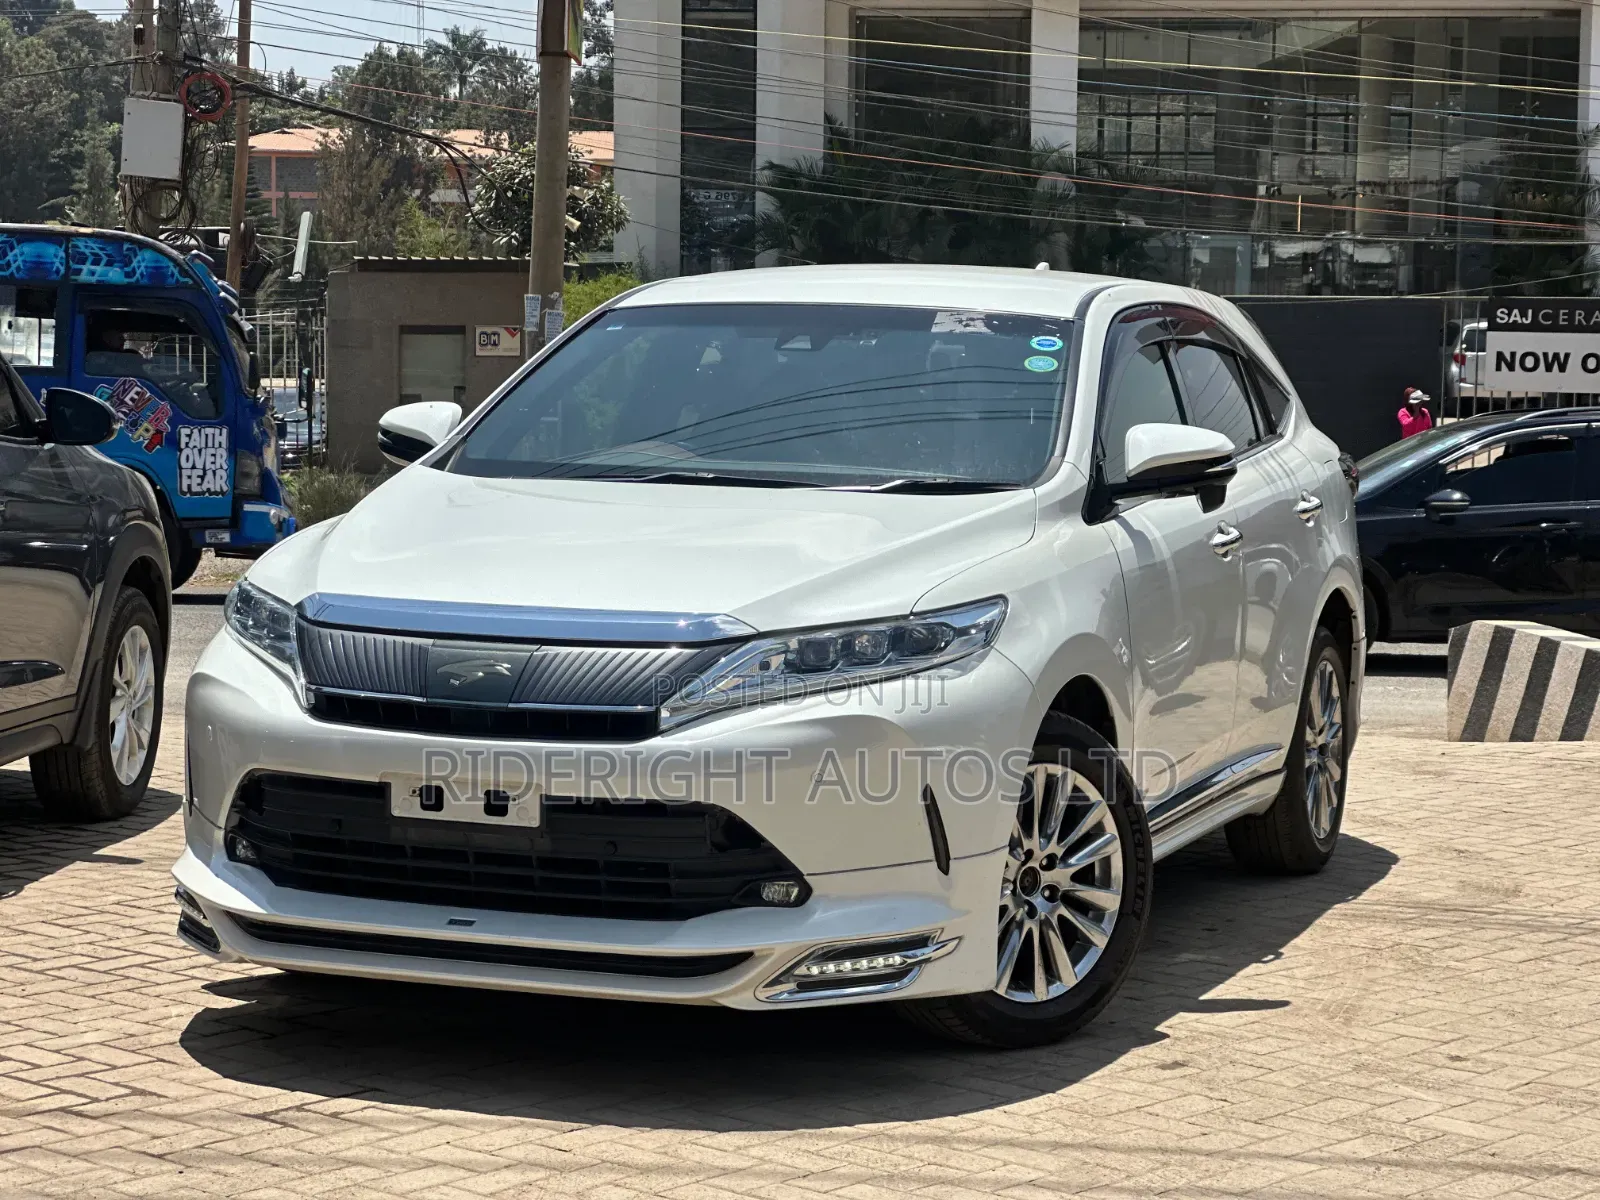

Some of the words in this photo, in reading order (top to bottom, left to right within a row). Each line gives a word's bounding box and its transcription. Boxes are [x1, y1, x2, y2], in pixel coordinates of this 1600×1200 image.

[1496, 308, 1533, 324] SAJ
[1538, 309, 1600, 325] CERA
[1495, 351, 1571, 373] NOW
[1581, 352, 1600, 374] O
[113, 378, 172, 432] NEVER
[179, 427, 228, 449] FAITH
[179, 447, 229, 470] OVER
[180, 468, 229, 492] FEAR
